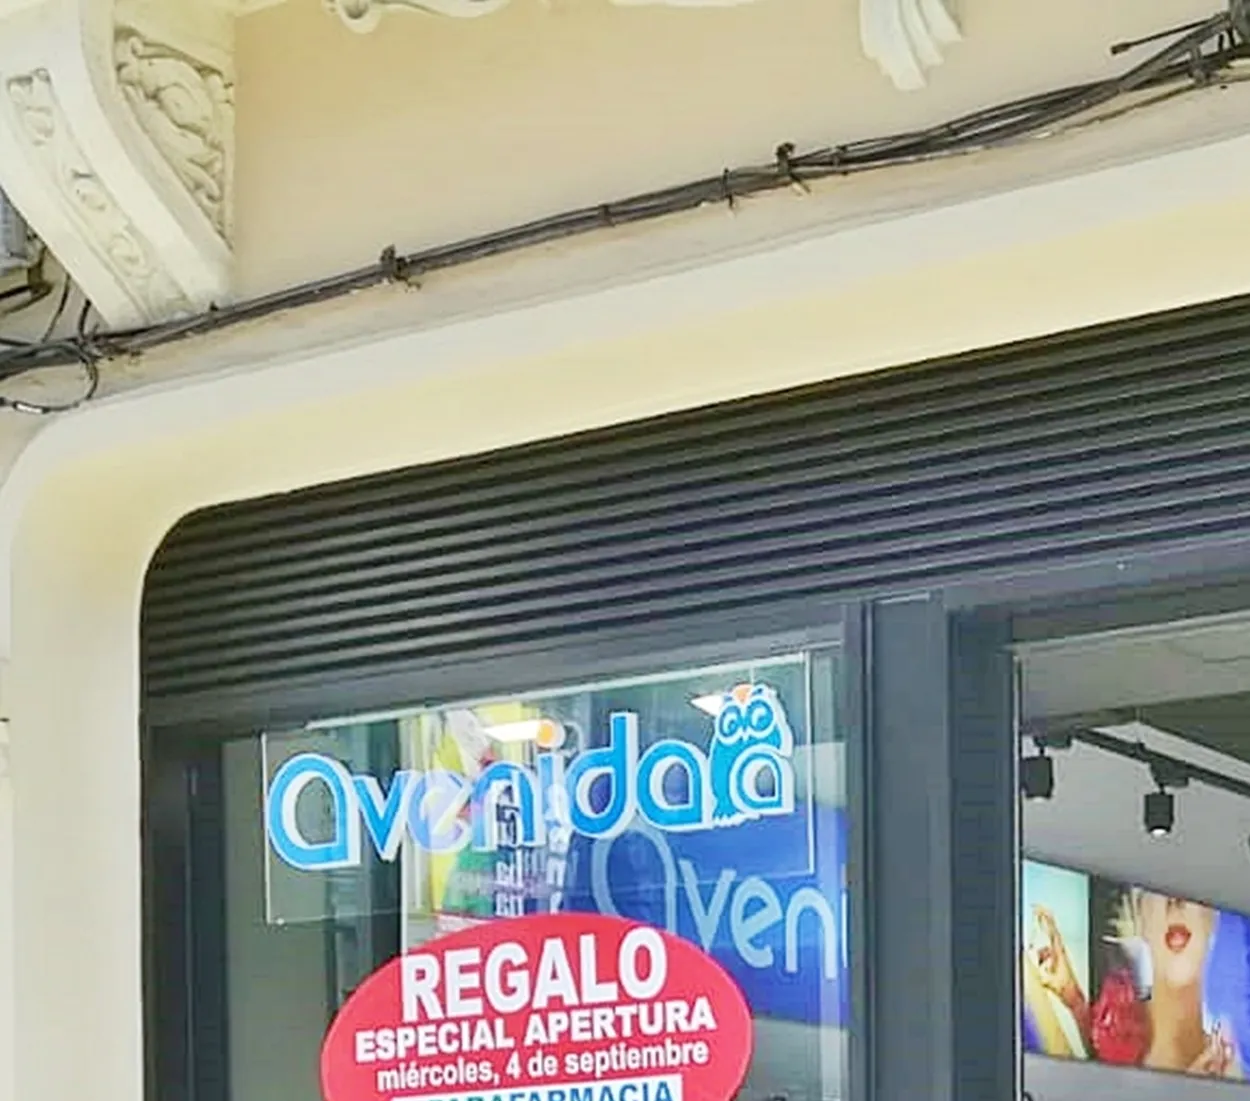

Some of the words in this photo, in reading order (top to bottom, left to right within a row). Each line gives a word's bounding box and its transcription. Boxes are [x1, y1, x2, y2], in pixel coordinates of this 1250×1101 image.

[402, 926, 668, 1023] REGALO
[355, 1017, 514, 1062] ESPECIAL
[523, 996, 717, 1047] APERTURA
[377, 1058, 500, 1092] miércoles,
[506, 1053, 521, 1078] 4
[528, 1049, 559, 1077] de
[565, 1040, 709, 1080] septiembre
